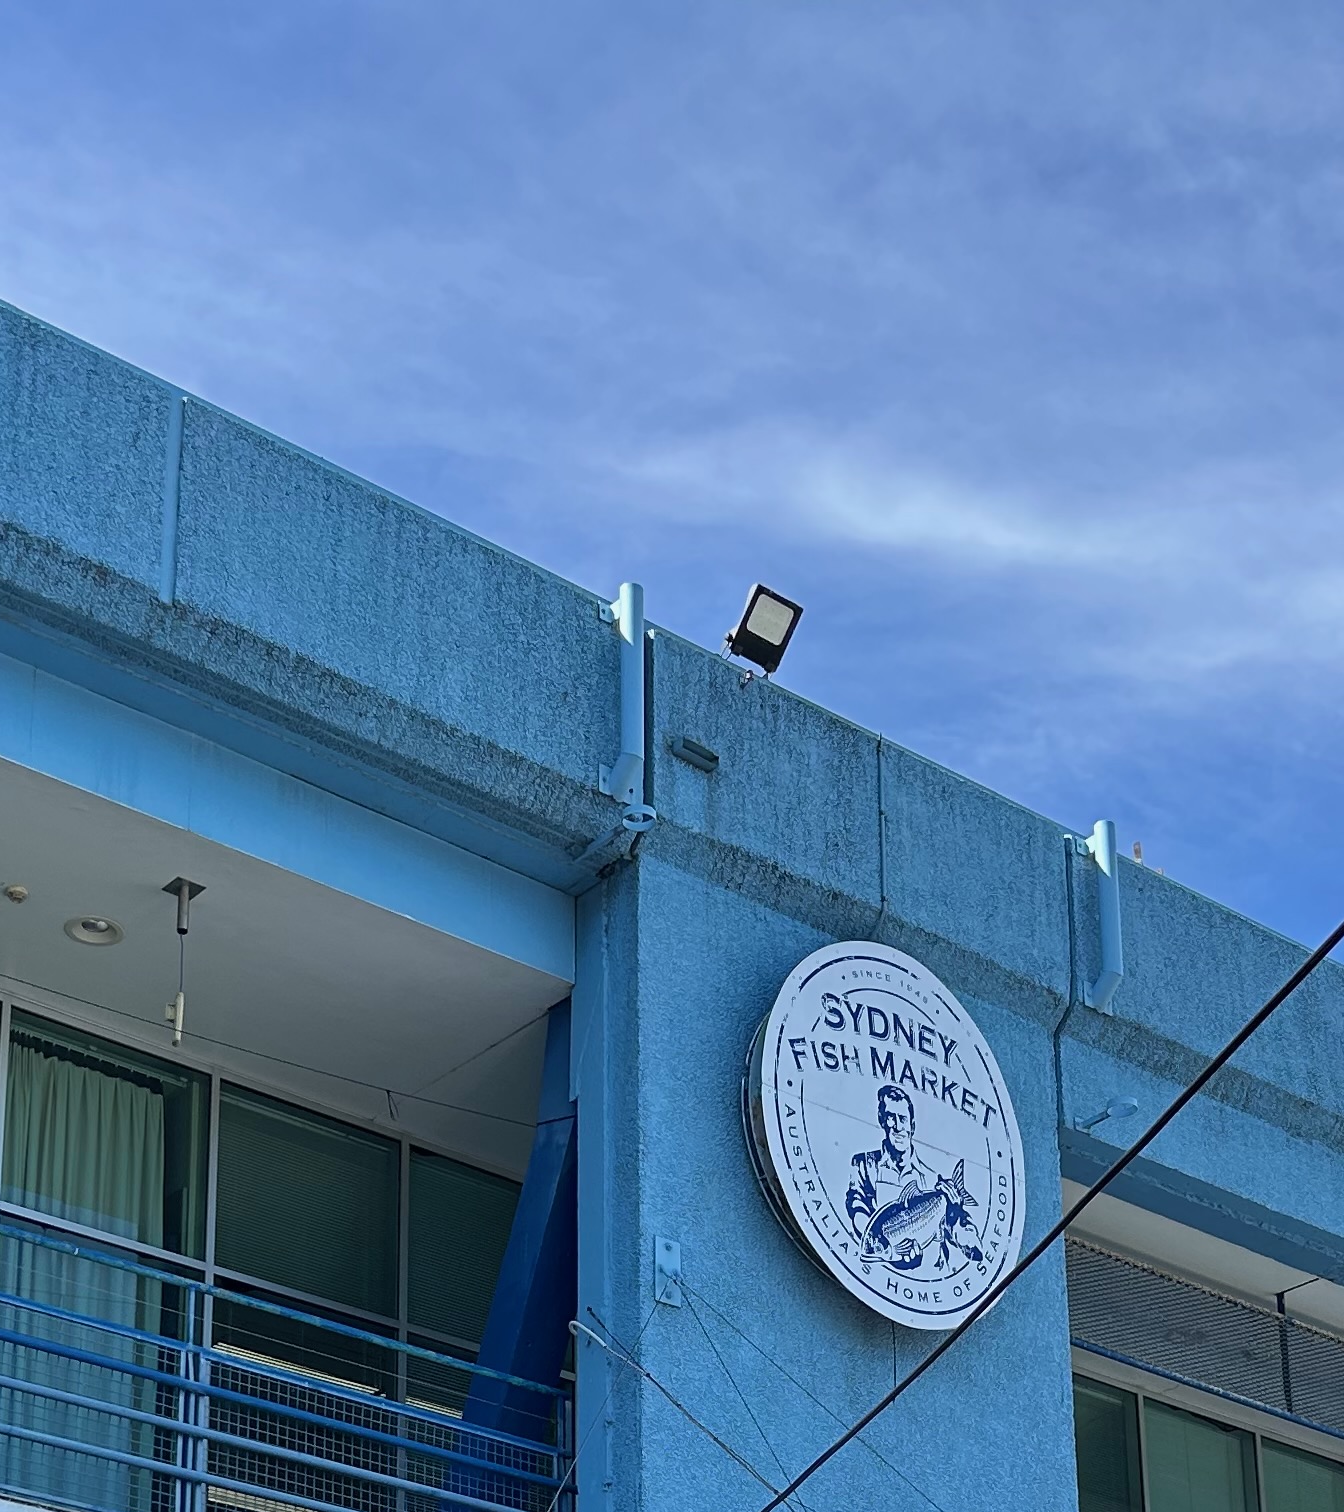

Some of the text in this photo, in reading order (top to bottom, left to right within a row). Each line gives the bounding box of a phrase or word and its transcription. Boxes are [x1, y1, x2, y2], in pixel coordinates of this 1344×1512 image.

[852, 969, 891, 983] SINCE
[820, 992, 958, 1069] SYDNEY
[787, 1036, 997, 1130] FISH MARKET
[886, 1277, 943, 1304] HOME
[953, 1280, 973, 1297] OF
[975, 1173, 1009, 1277] SEAFOOD
